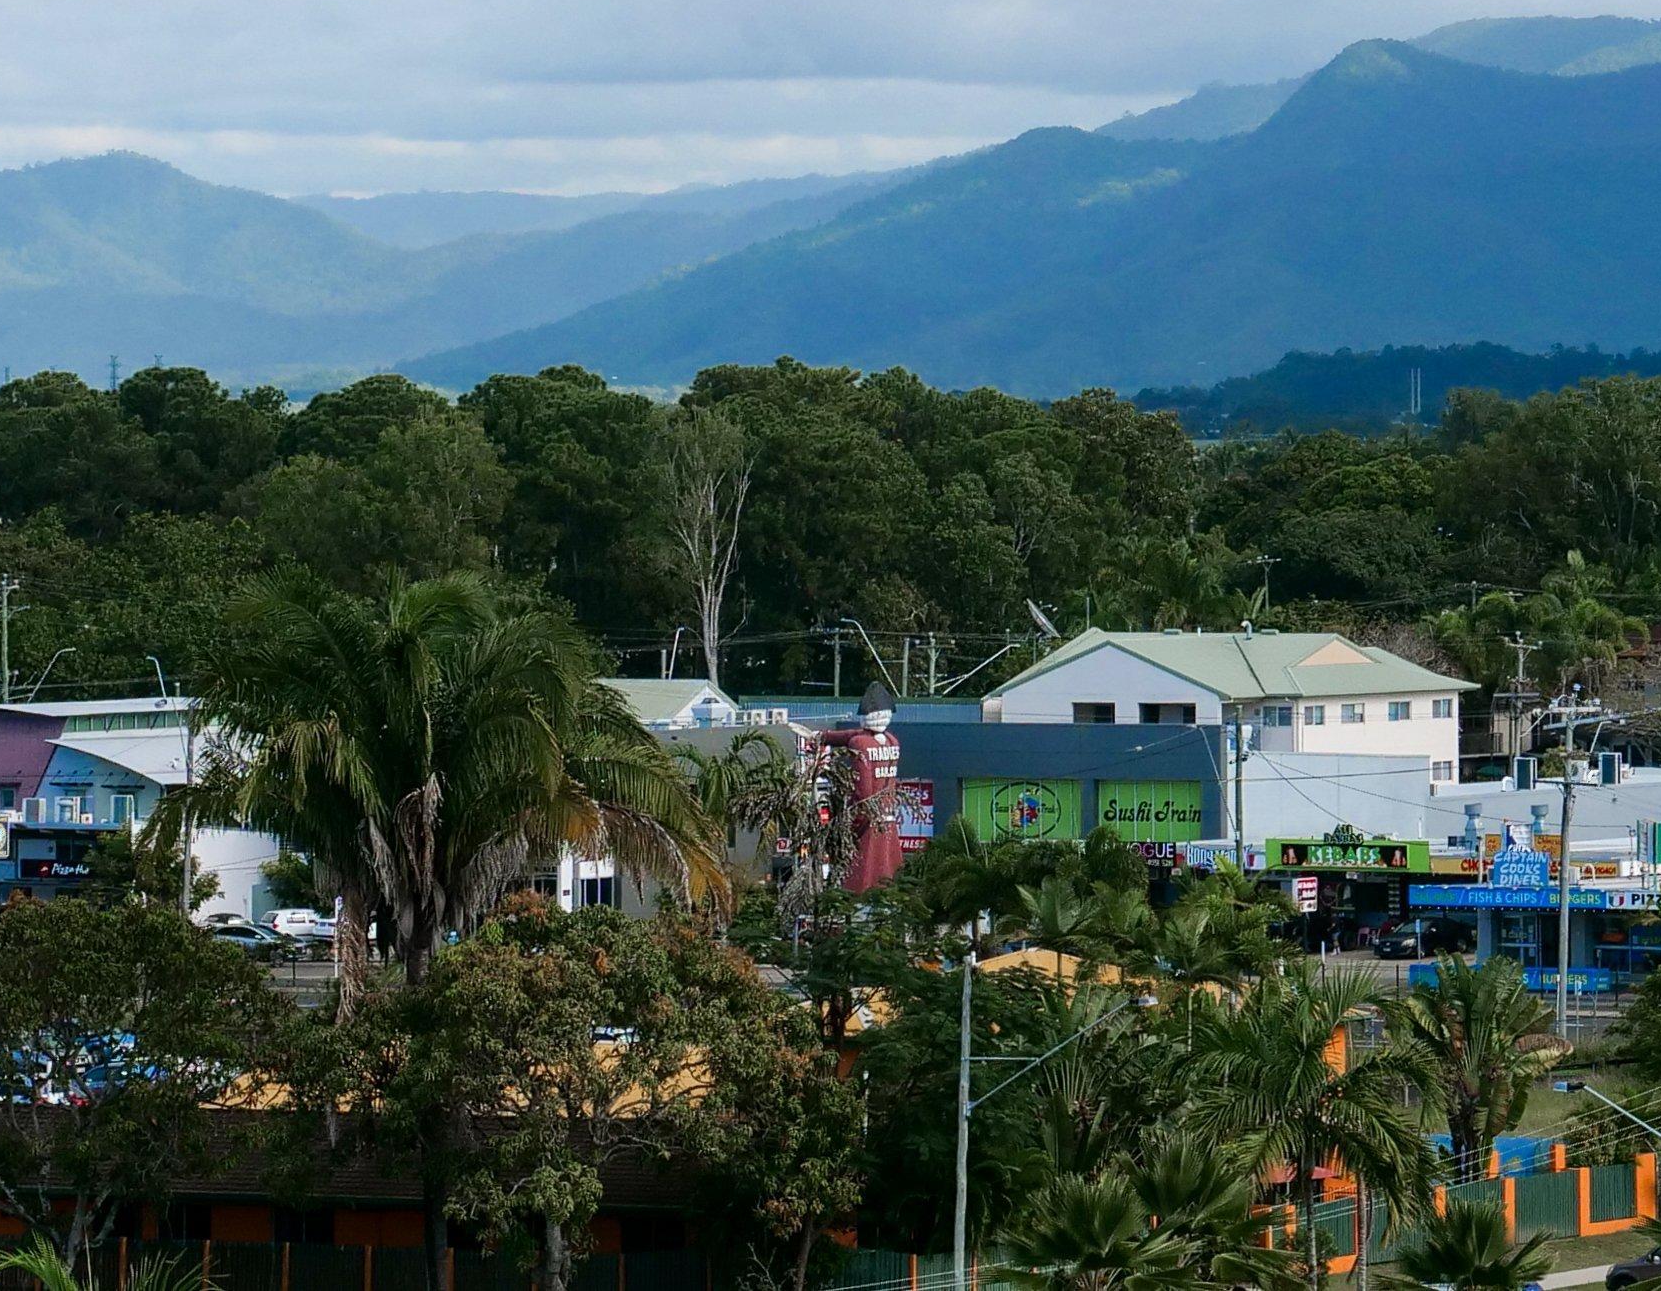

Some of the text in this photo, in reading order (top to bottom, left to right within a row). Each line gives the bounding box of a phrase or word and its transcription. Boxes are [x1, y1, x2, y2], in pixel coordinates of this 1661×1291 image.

[1104, 799, 1202, 822] Sushi Train
[1307, 845, 1381, 863] KEBABS
[1494, 852, 1547, 863] CAPTAIN
[51, 862, 74, 875] Pizza
[1468, 892, 1493, 903] FISH
[1507, 892, 1537, 904] CHIPS
